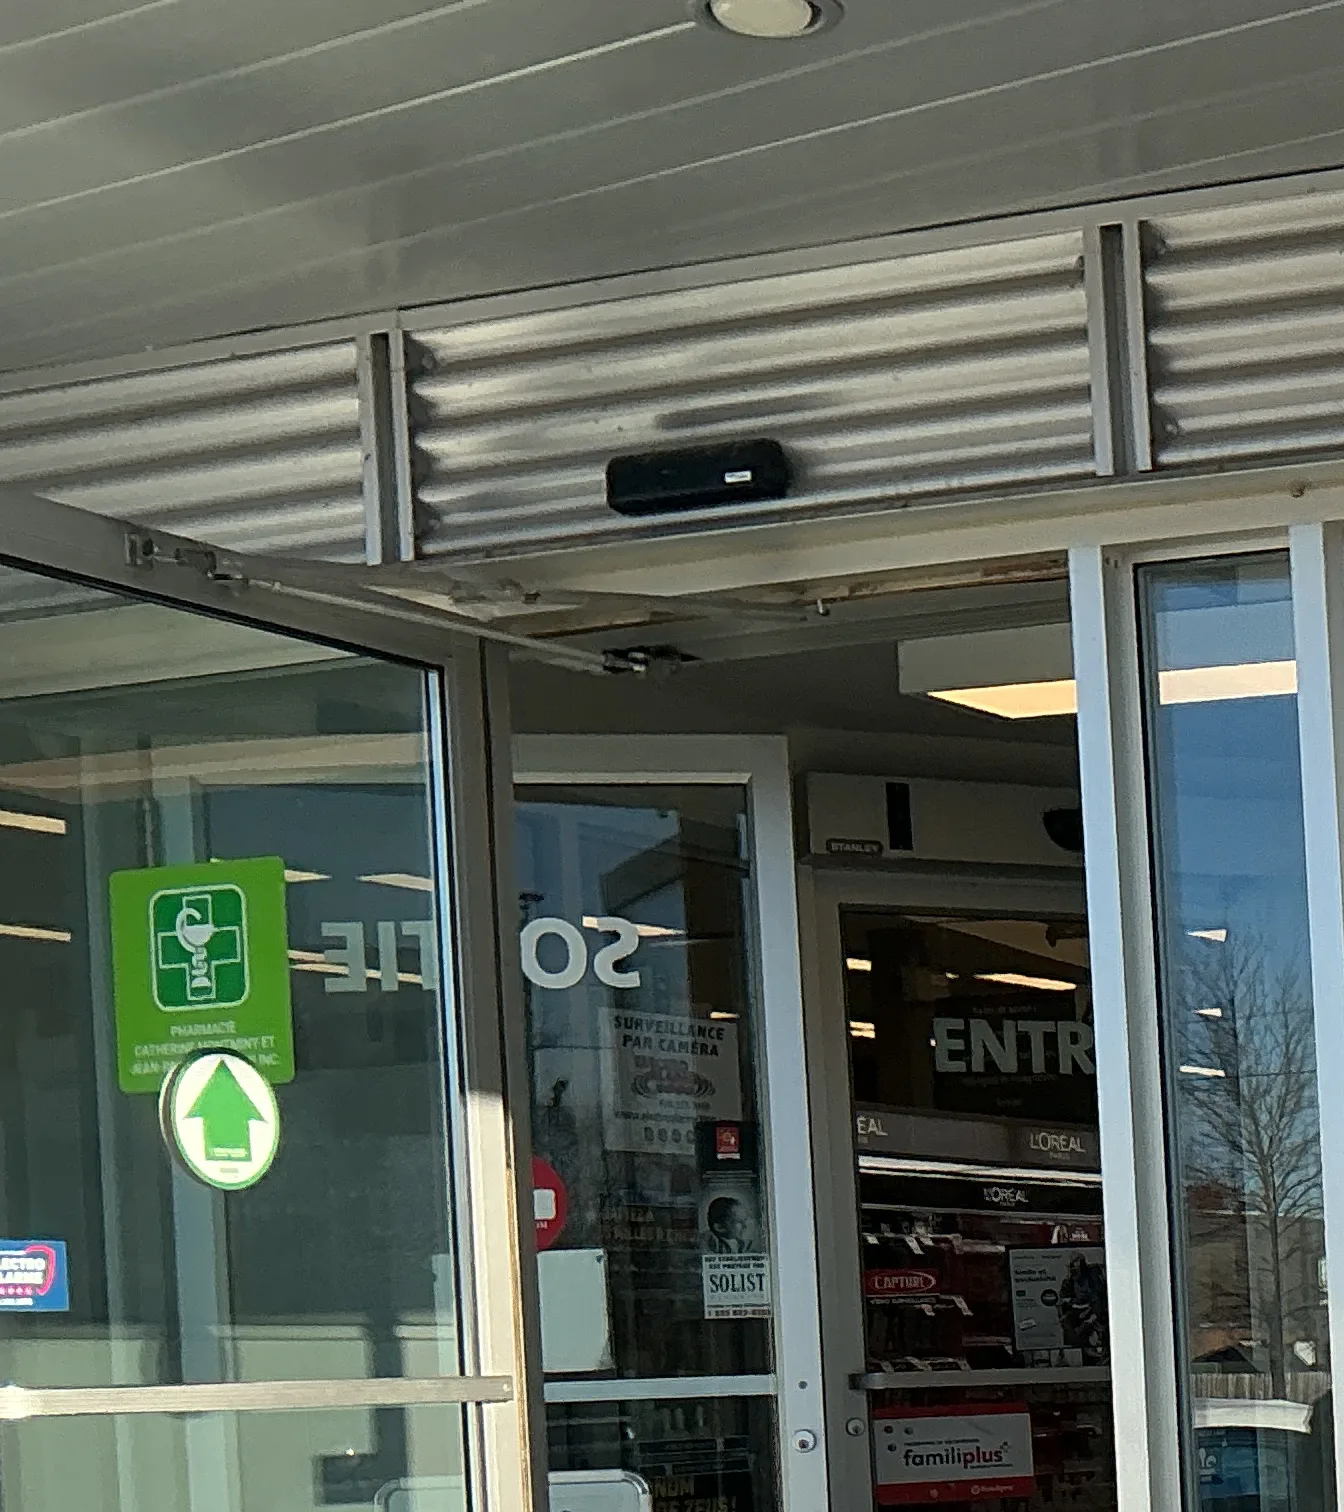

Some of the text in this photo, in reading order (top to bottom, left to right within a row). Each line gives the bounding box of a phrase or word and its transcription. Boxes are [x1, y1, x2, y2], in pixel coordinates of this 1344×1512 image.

[614, 1014, 726, 1042] SURVEILLANCE
[622, 1033, 719, 1058] PAR CAMÉRA
[932, 1017, 1098, 1076] ENTR
[1030, 1130, 1086, 1153] L'ORÉAL
[709, 1272, 766, 1293] SOLIST
[903, 1445, 1004, 1470] familiplus
